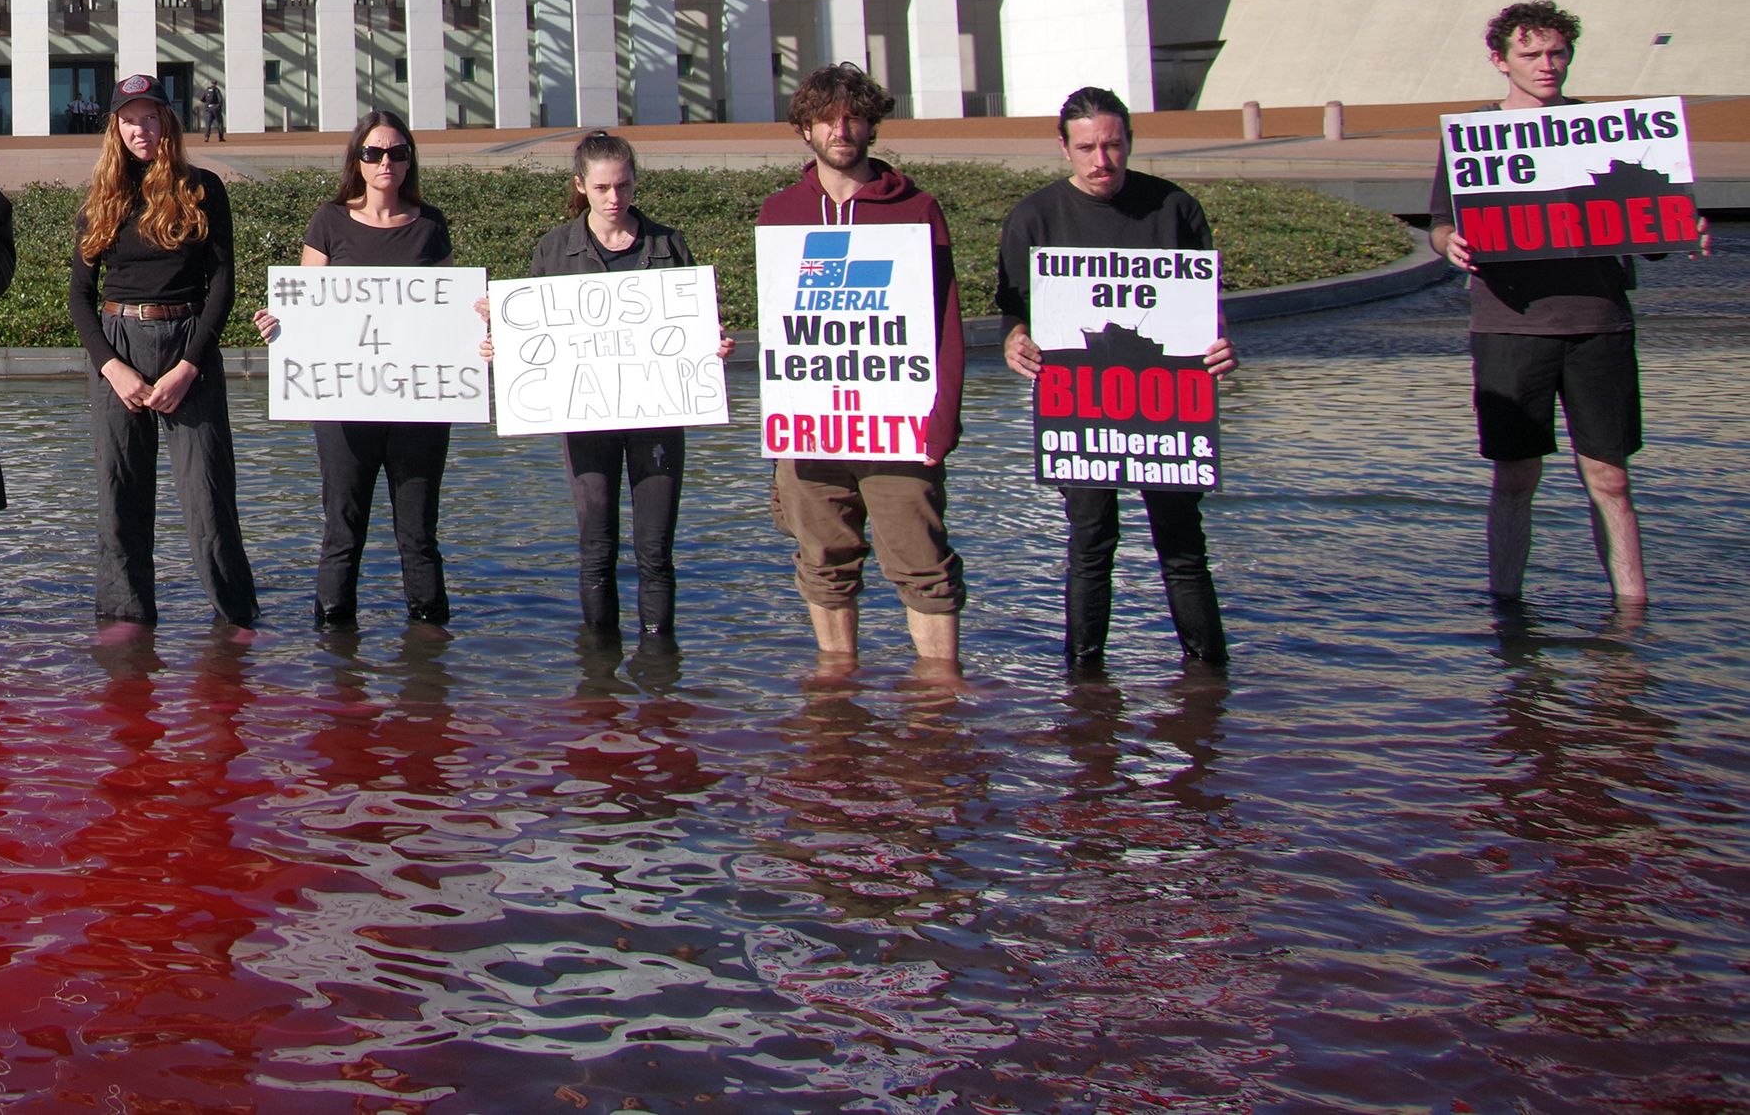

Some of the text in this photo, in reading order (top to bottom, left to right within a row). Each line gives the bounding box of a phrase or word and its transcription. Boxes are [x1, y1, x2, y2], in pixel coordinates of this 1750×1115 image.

[1448, 108, 1679, 153] turnbacks
[1454, 153, 1537, 188] are
[1461, 195, 1699, 253] MURDER
[1037, 251, 1213, 280] turnbacks
[273, 276, 453, 307] #JUSTICE
[501, 269, 699, 330] CLOSE
[794, 290, 890, 311] LIBERAL
[1092, 283, 1157, 309] are
[358, 314, 392, 355] 4
[568, 328, 636, 359] THE
[783, 315, 907, 346] World
[282, 357, 482, 401] REFUGEES
[765, 349, 931, 382] Leaders
[507, 353, 725, 423] CAMPS
[833, 385, 860, 411] in
[1038, 364, 1215, 423] BLOOD
[766, 413, 931, 454] CRUELTY
[1041, 427, 1213, 458] on Liberal &
[1042, 454, 1215, 485] Labor hands
